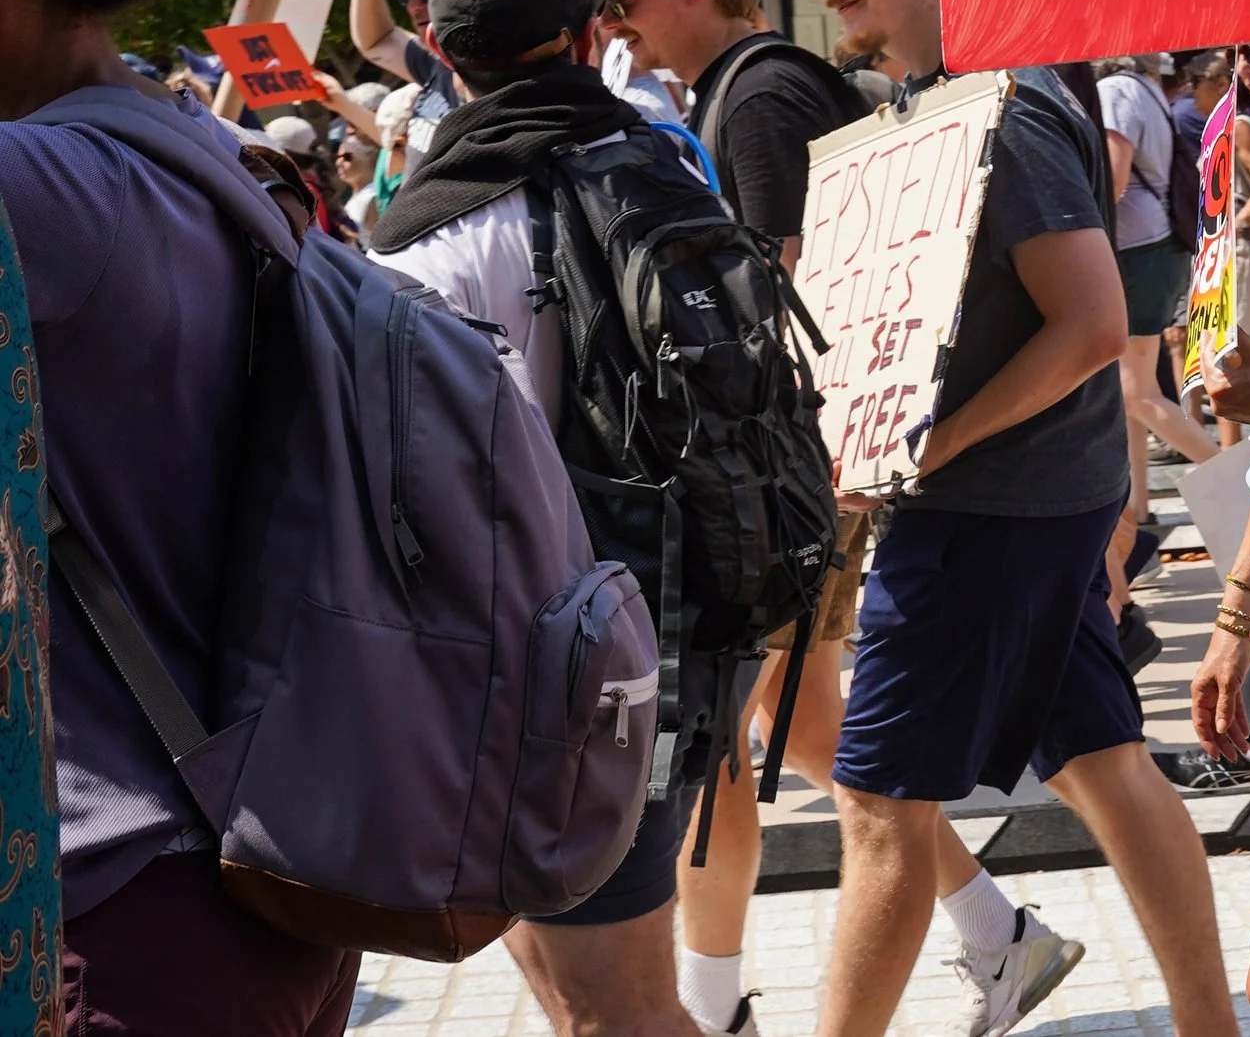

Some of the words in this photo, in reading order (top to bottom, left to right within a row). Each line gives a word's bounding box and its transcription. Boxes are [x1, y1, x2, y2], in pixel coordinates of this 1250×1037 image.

[806, 108, 992, 282] EPSTEIN
[819, 255, 921, 332] FILES
[813, 336, 854, 392] ILL
[867, 318, 923, 375] SET
[839, 384, 918, 469] FREE
